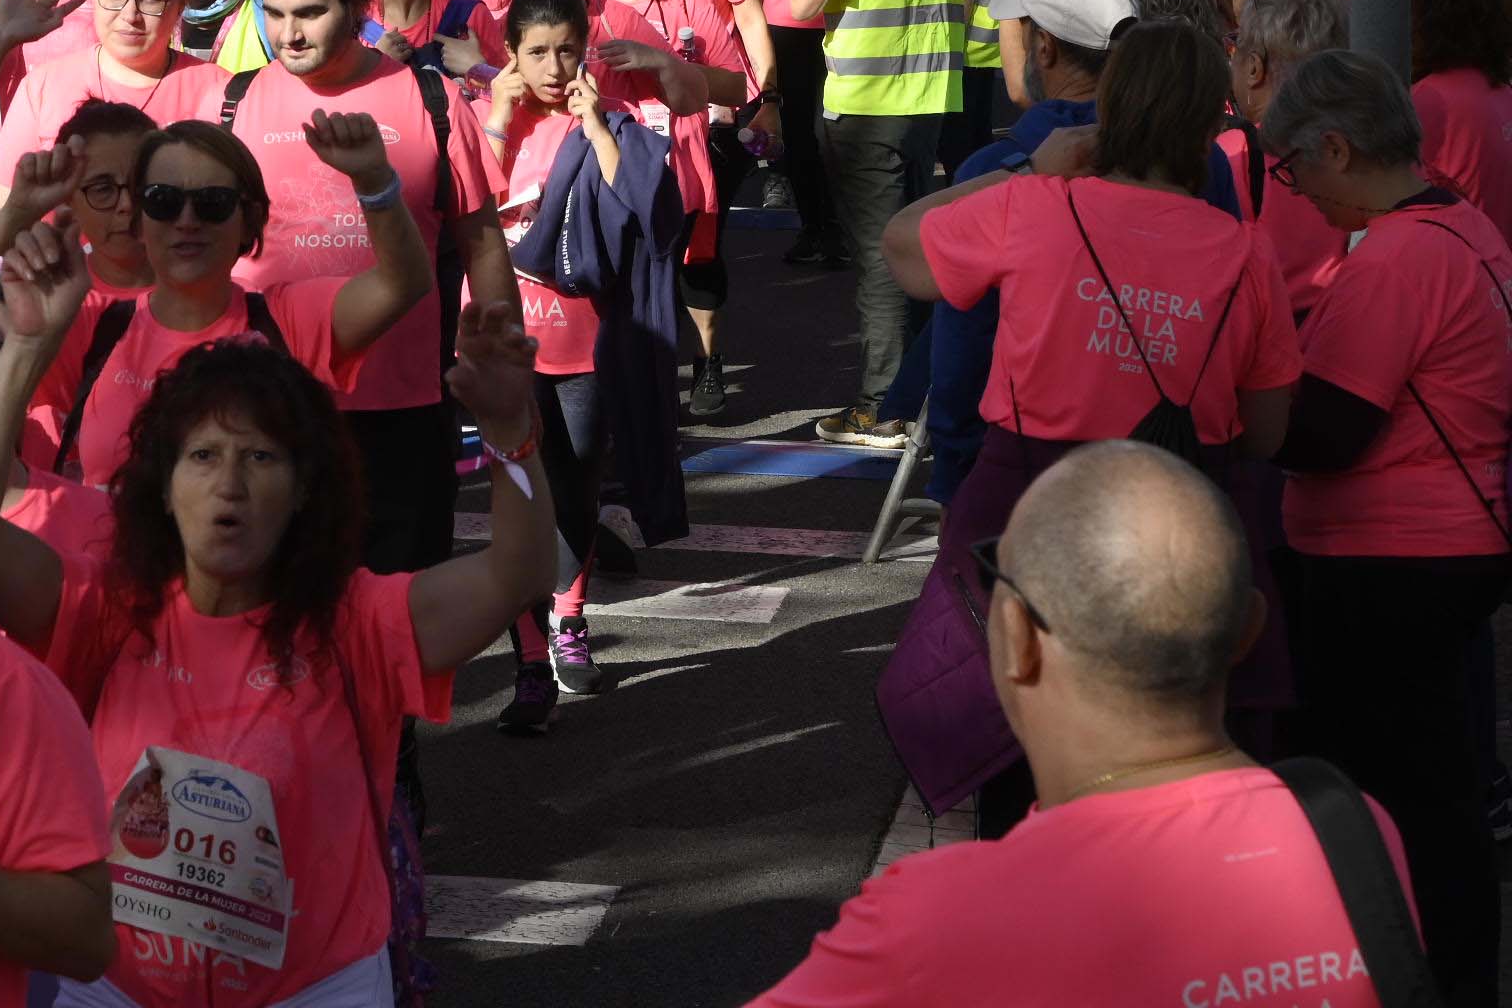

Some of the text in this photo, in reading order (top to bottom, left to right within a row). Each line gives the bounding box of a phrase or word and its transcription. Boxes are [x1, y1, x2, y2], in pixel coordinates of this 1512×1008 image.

[295, 235, 372, 248] NOSOTR
[561, 230, 571, 275] BERLINALE
[1077, 277, 1205, 322] CARRERA
[1097, 306, 1176, 341] DE LA
[1086, 330, 1177, 366] MUJER
[1118, 362, 1143, 374] 2023
[179, 784, 247, 818] ASTURIANA
[174, 828, 236, 866] 016
[124, 871, 175, 895] CARRERA
[177, 885, 192, 899] DE
[195, 889, 208, 902] LA
[211, 894, 247, 914] MUJER
[176, 862, 226, 888] 19362
[114, 893, 171, 921] OYSHO
[1182, 948, 1370, 1008] CARRERA
